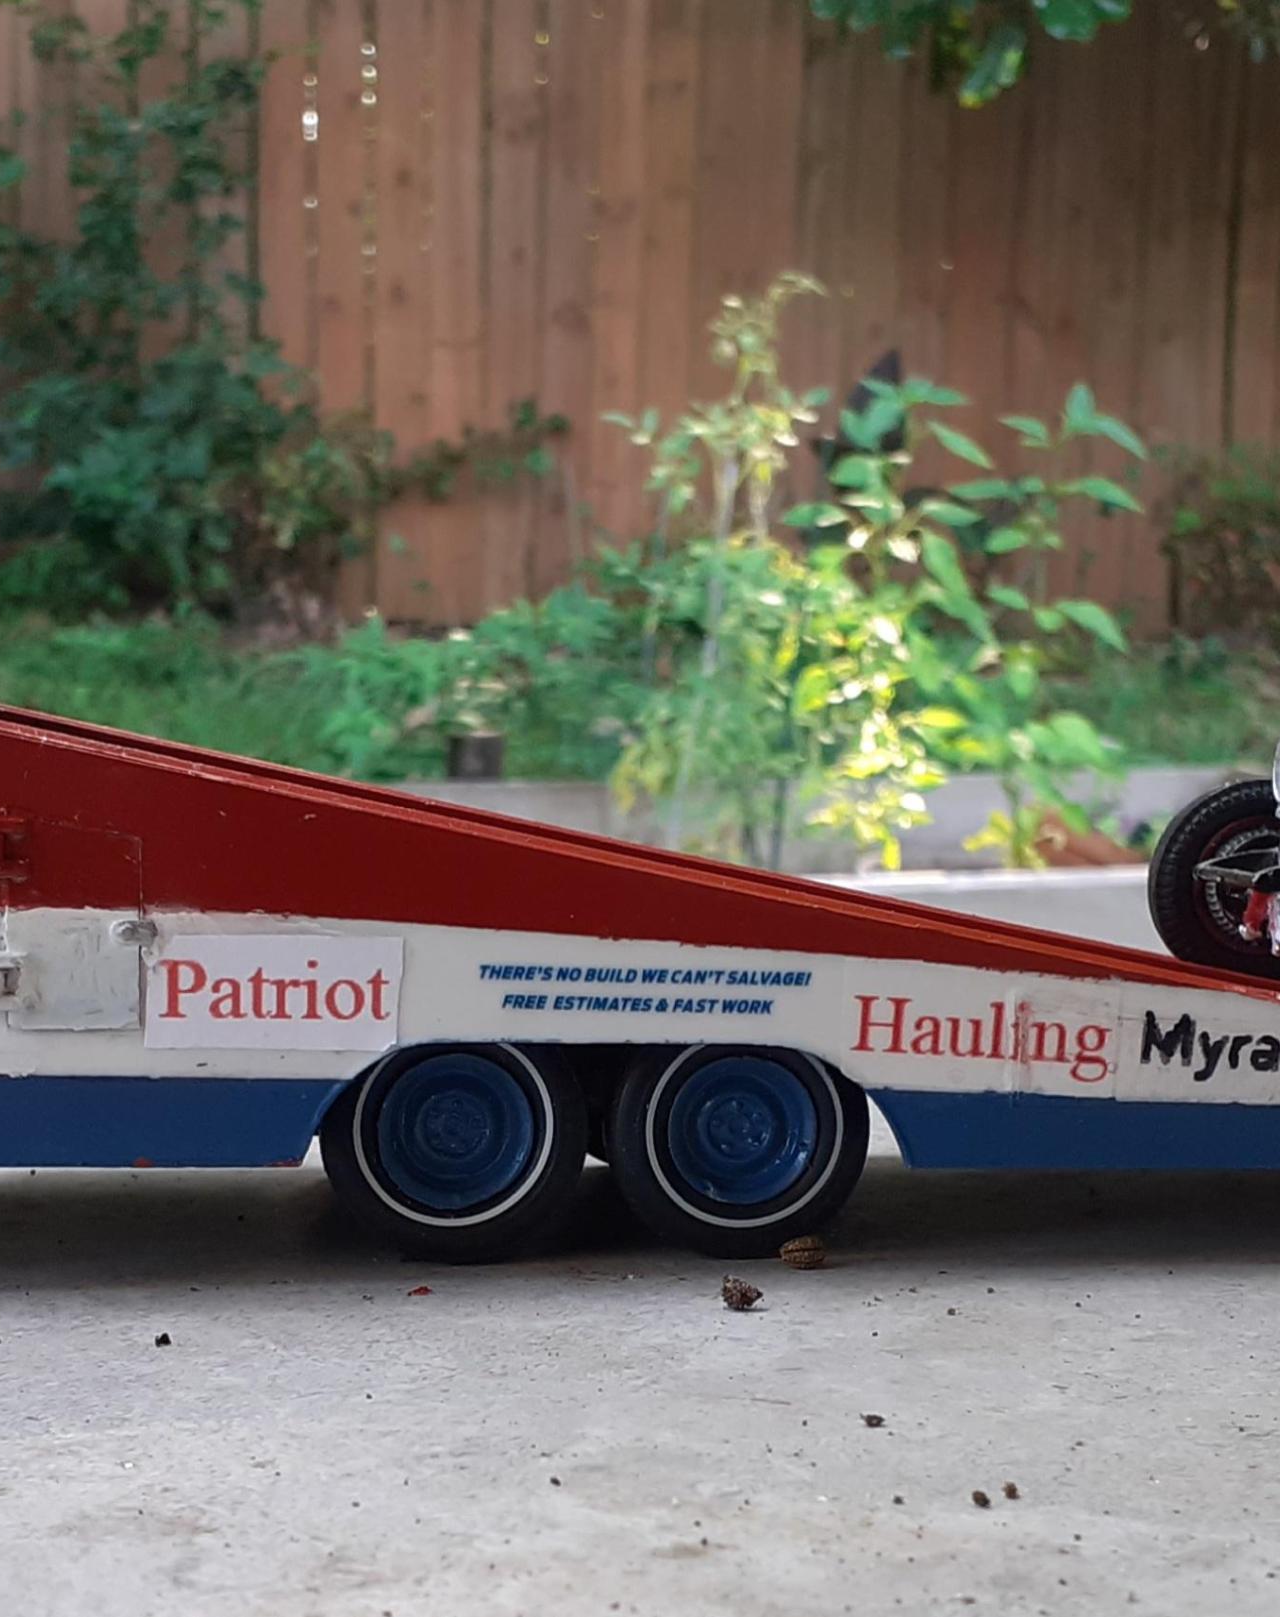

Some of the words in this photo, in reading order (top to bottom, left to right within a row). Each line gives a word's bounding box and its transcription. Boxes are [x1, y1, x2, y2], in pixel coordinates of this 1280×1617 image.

[158, 958, 391, 1021] Patriot
[479, 964, 554, 982] THERE'S
[556, 967, 583, 983] NO
[584, 968, 638, 984] BUILD
[641, 969, 669, 984] WE
[670, 969, 726, 985] CAN'T
[726, 970, 813, 987] SALVAGE!
[502, 994, 549, 1011] FREE
[552, 995, 653, 1012] ESTIMATES
[654, 998, 669, 1013] &
[671, 998, 720, 1014] FAST
[721, 999, 774, 1015] WORK
[849, 994, 1113, 1083] Hauling
